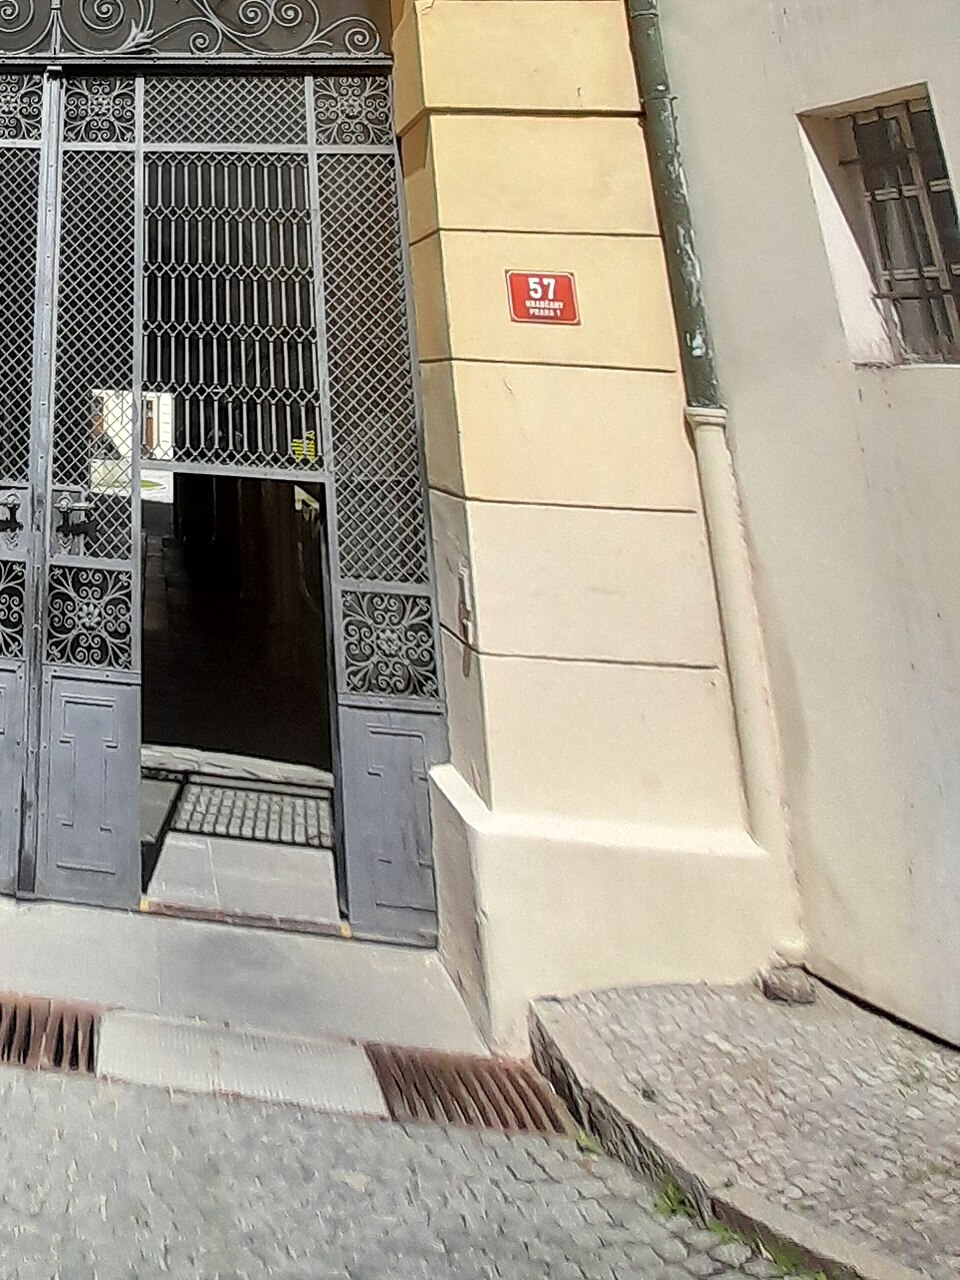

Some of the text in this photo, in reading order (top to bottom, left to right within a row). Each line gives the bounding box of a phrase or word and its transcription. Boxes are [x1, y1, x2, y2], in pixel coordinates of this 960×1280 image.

[527, 277, 556, 300] 57
[529, 308, 561, 317] PRAHA 1
